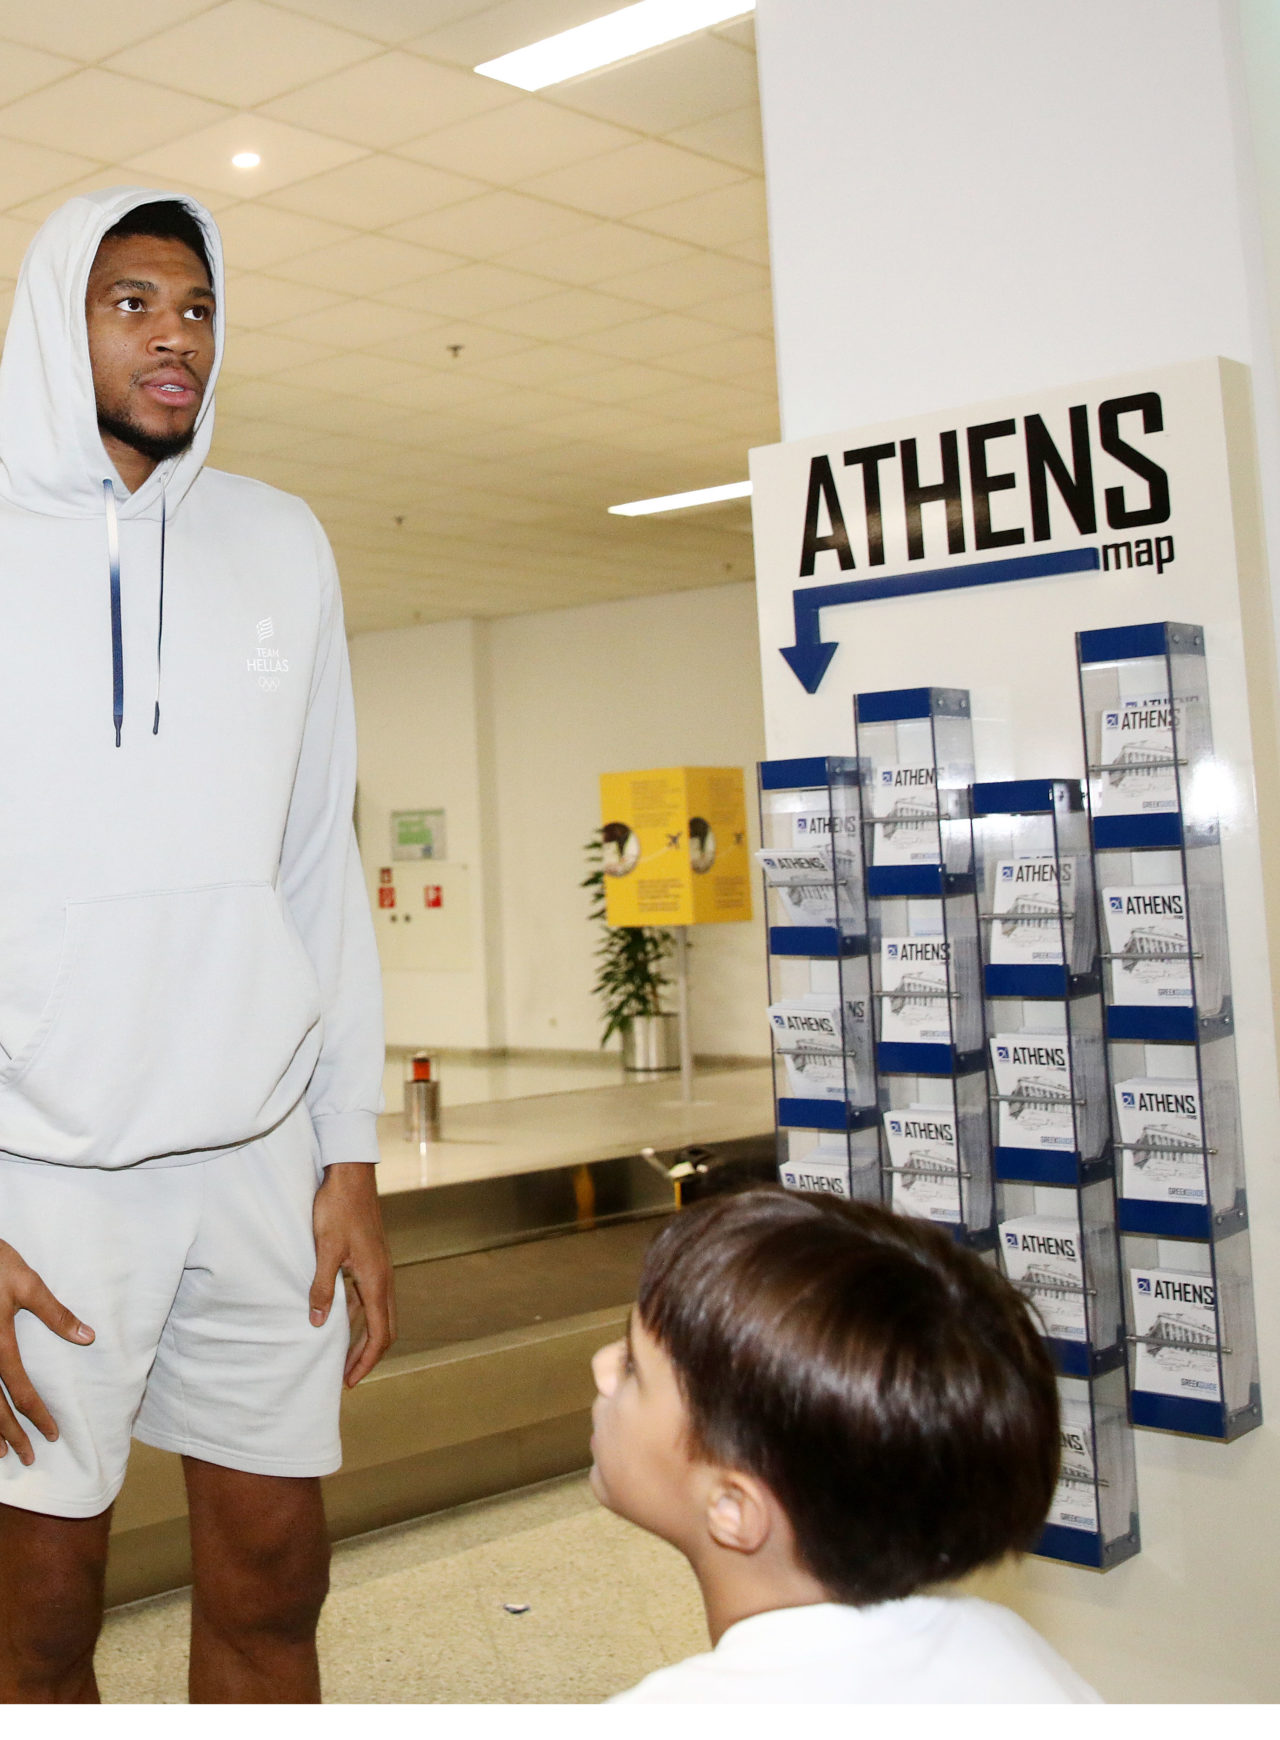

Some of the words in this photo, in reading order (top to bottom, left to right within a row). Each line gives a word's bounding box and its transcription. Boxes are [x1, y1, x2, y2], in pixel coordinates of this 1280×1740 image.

[799, 391, 1171, 577] ATHENS
[1103, 535, 1175, 574] map
[256, 647, 280, 658] TEAM
[246, 659, 289, 672] HELLAS
[1121, 708, 1180, 730] ATHENS
[777, 857, 825, 870] ATHENS
[1015, 863, 1072, 882] ATHENS
[1126, 895, 1183, 915] ATHENS
[900, 943, 951, 961] ATHENS
[787, 1015, 834, 1034] ATHENS
[1012, 1046, 1066, 1067] ATHENS
[1138, 1092, 1196, 1114] ATHENS
[904, 1121, 954, 1141] ATHENS
[798, 1173, 844, 1195] ATHENS
[1021, 1234, 1076, 1257] ATHENS
[1154, 1279, 1215, 1305] ATHENS
